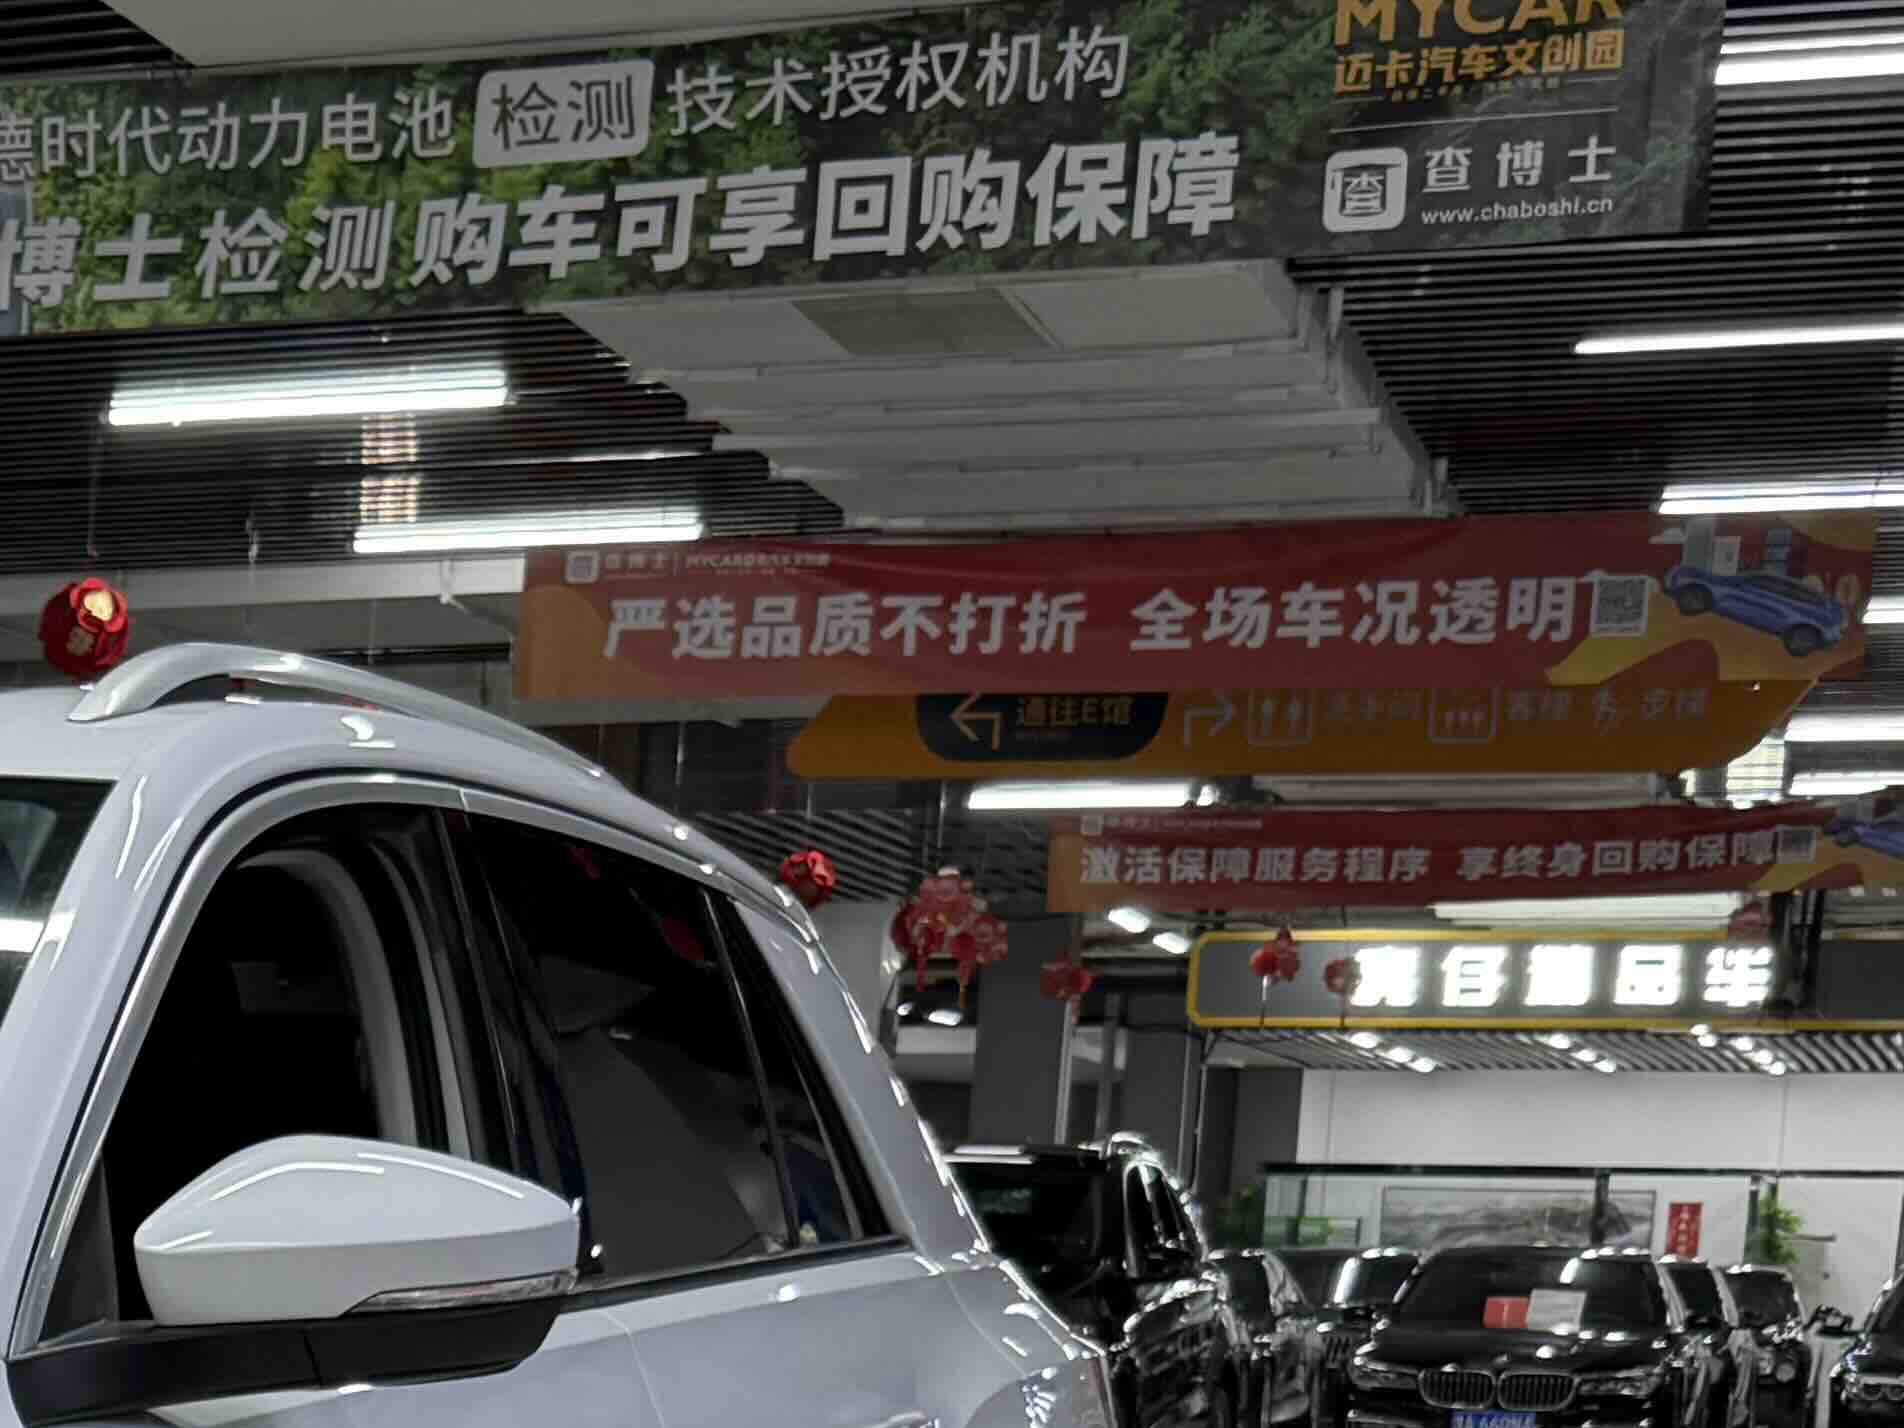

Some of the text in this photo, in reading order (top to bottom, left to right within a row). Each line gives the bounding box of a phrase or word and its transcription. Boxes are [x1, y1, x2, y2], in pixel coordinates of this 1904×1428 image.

[1335, 29, 1624, 93] 迈卡汽车文创园
[1421, 136, 1617, 192] 查博士
[1421, 196, 1614, 225] www.chaboshi.cn
[604, 576, 1576, 658] 严选品质不打折 全场车况透明
[1081, 831, 1774, 883] 激活保障服务程序 享终身回购保障
